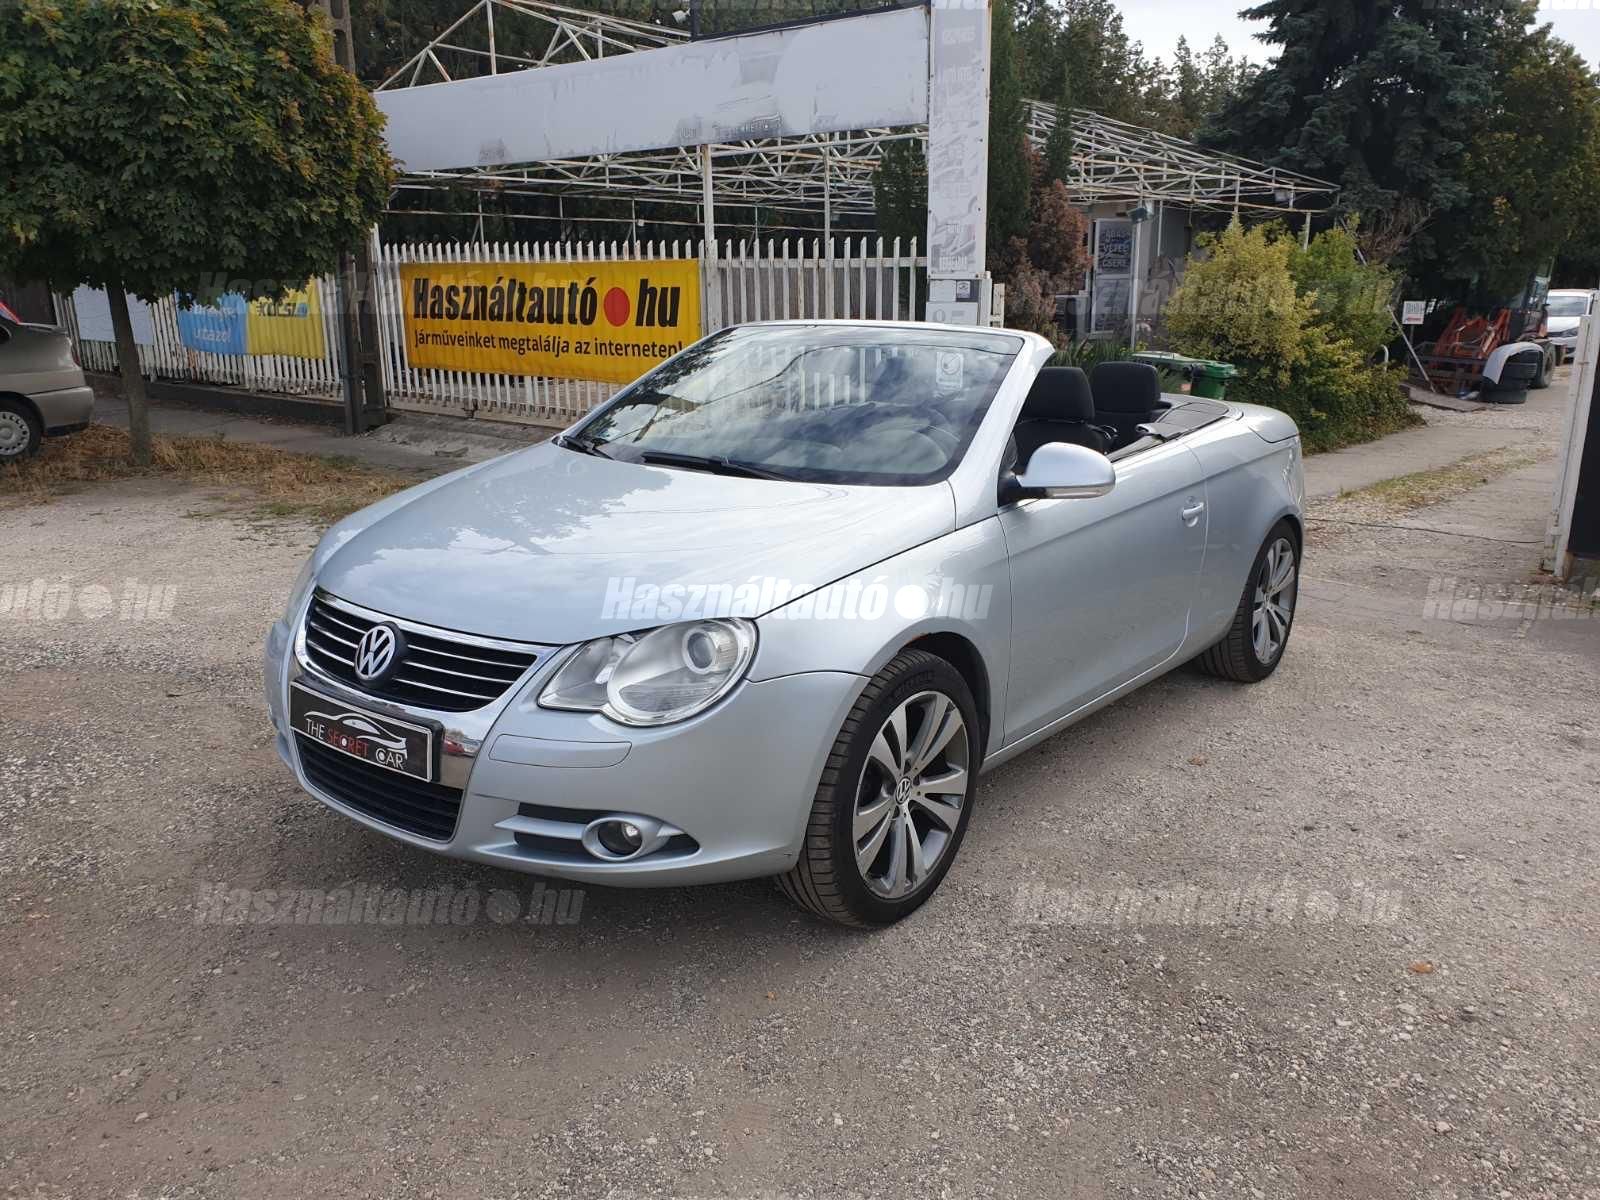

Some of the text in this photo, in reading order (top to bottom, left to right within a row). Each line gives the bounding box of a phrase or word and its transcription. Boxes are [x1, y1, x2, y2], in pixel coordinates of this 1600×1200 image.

[414, 329, 496, 349] Járműveinket
[499, 333, 570, 358] megtalálja
[574, 339, 591, 355] az
[305, 719, 404, 771] THE SECRET CAR
